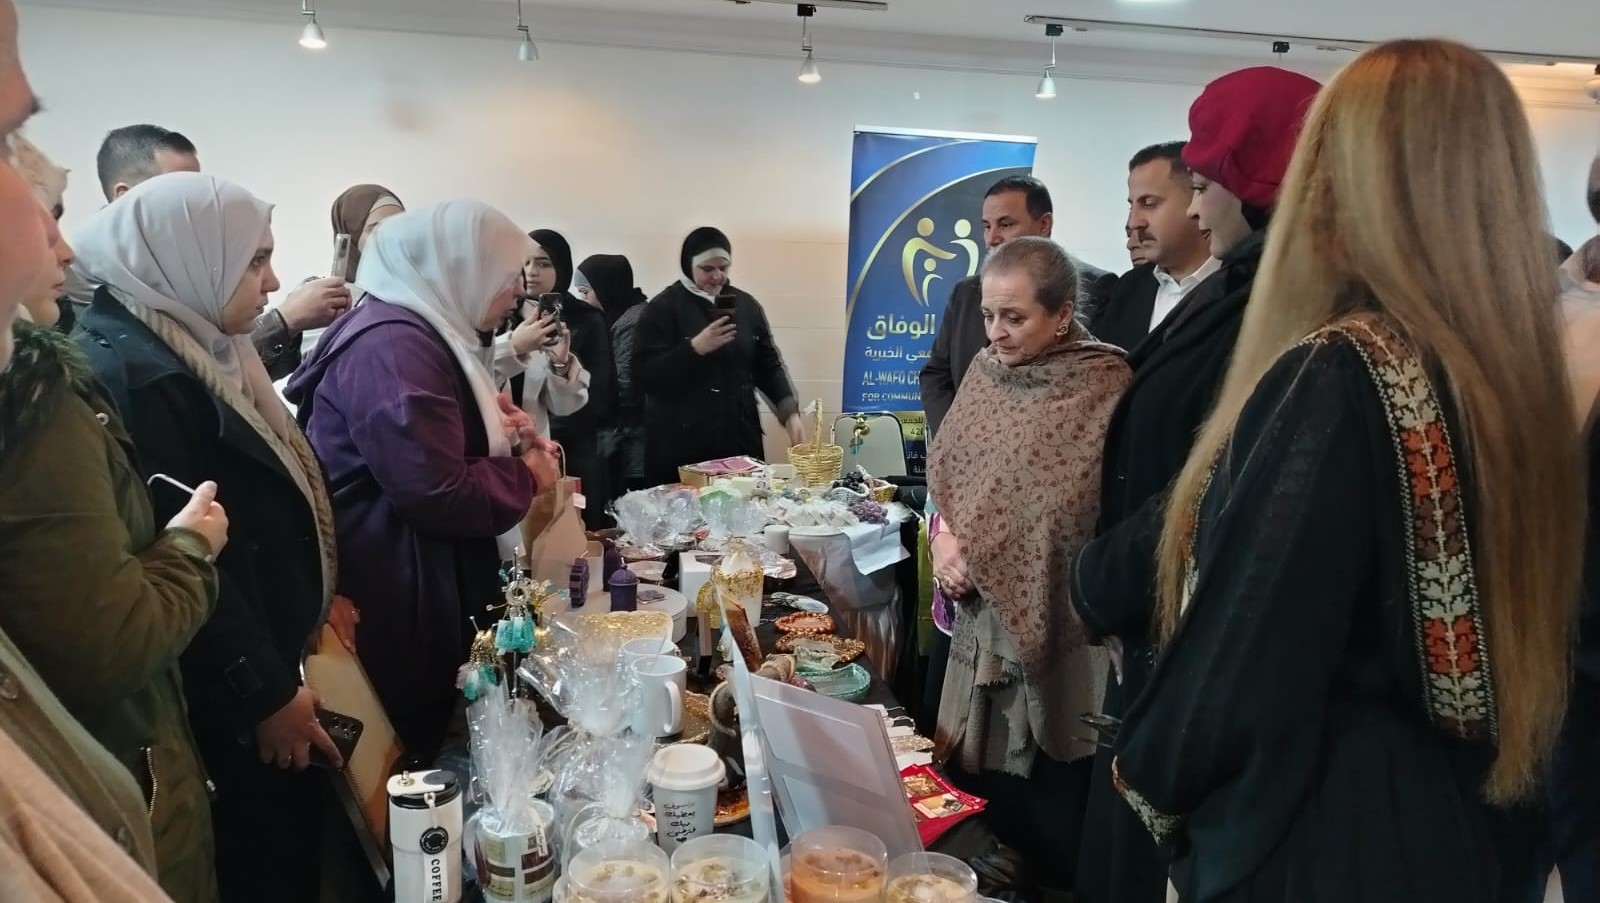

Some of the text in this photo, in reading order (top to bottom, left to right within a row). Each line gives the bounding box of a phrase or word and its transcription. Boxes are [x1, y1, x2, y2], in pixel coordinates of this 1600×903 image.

[867, 313, 936, 340] الوفاق
[864, 345, 903, 361] الخيرية
[862, 370, 905, 385] AL-WAFQ
[862, 392, 880, 401] FOR
[431, 859, 442, 901] COFFEE
